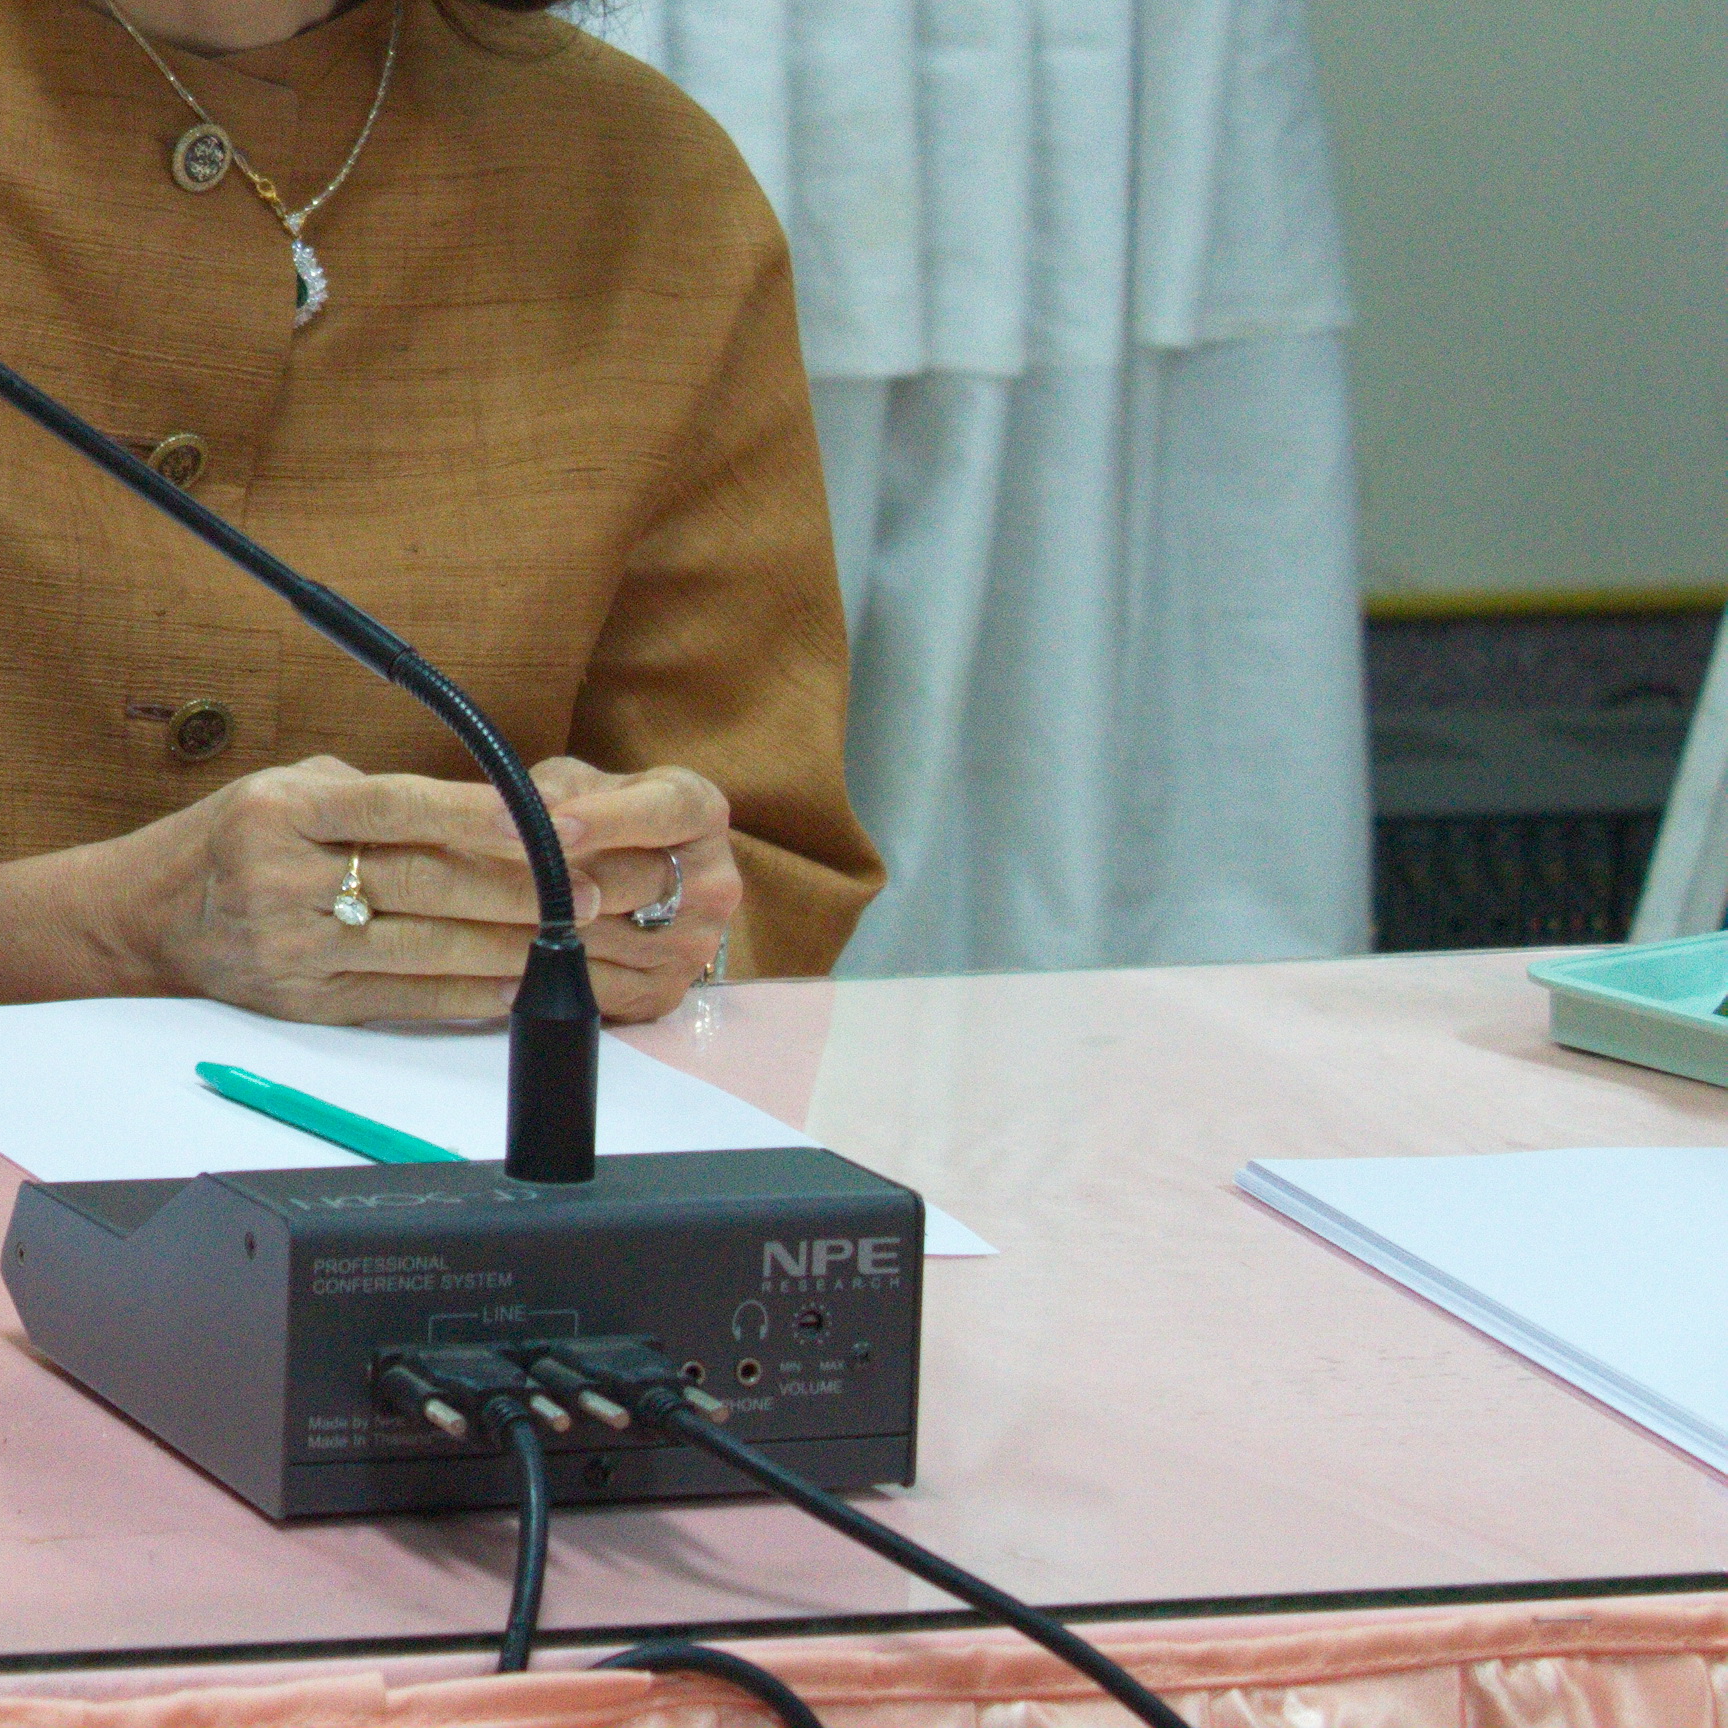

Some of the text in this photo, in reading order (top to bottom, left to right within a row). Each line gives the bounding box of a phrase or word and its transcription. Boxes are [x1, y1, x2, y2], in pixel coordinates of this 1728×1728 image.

[313, 1257, 449, 1275] PROFESSIONAL
[761, 1237, 901, 1278] NPE
[312, 1272, 513, 1295] CONFERENCE SYSTEM
[761, 1278, 902, 1293] RESEARCH
[482, 1305, 527, 1324] LINE
[819, 1359, 846, 1372] MAX
[778, 1379, 844, 1396] VOLUME
[307, 1416, 348, 1431] Made
[307, 1434, 348, 1450] Made
